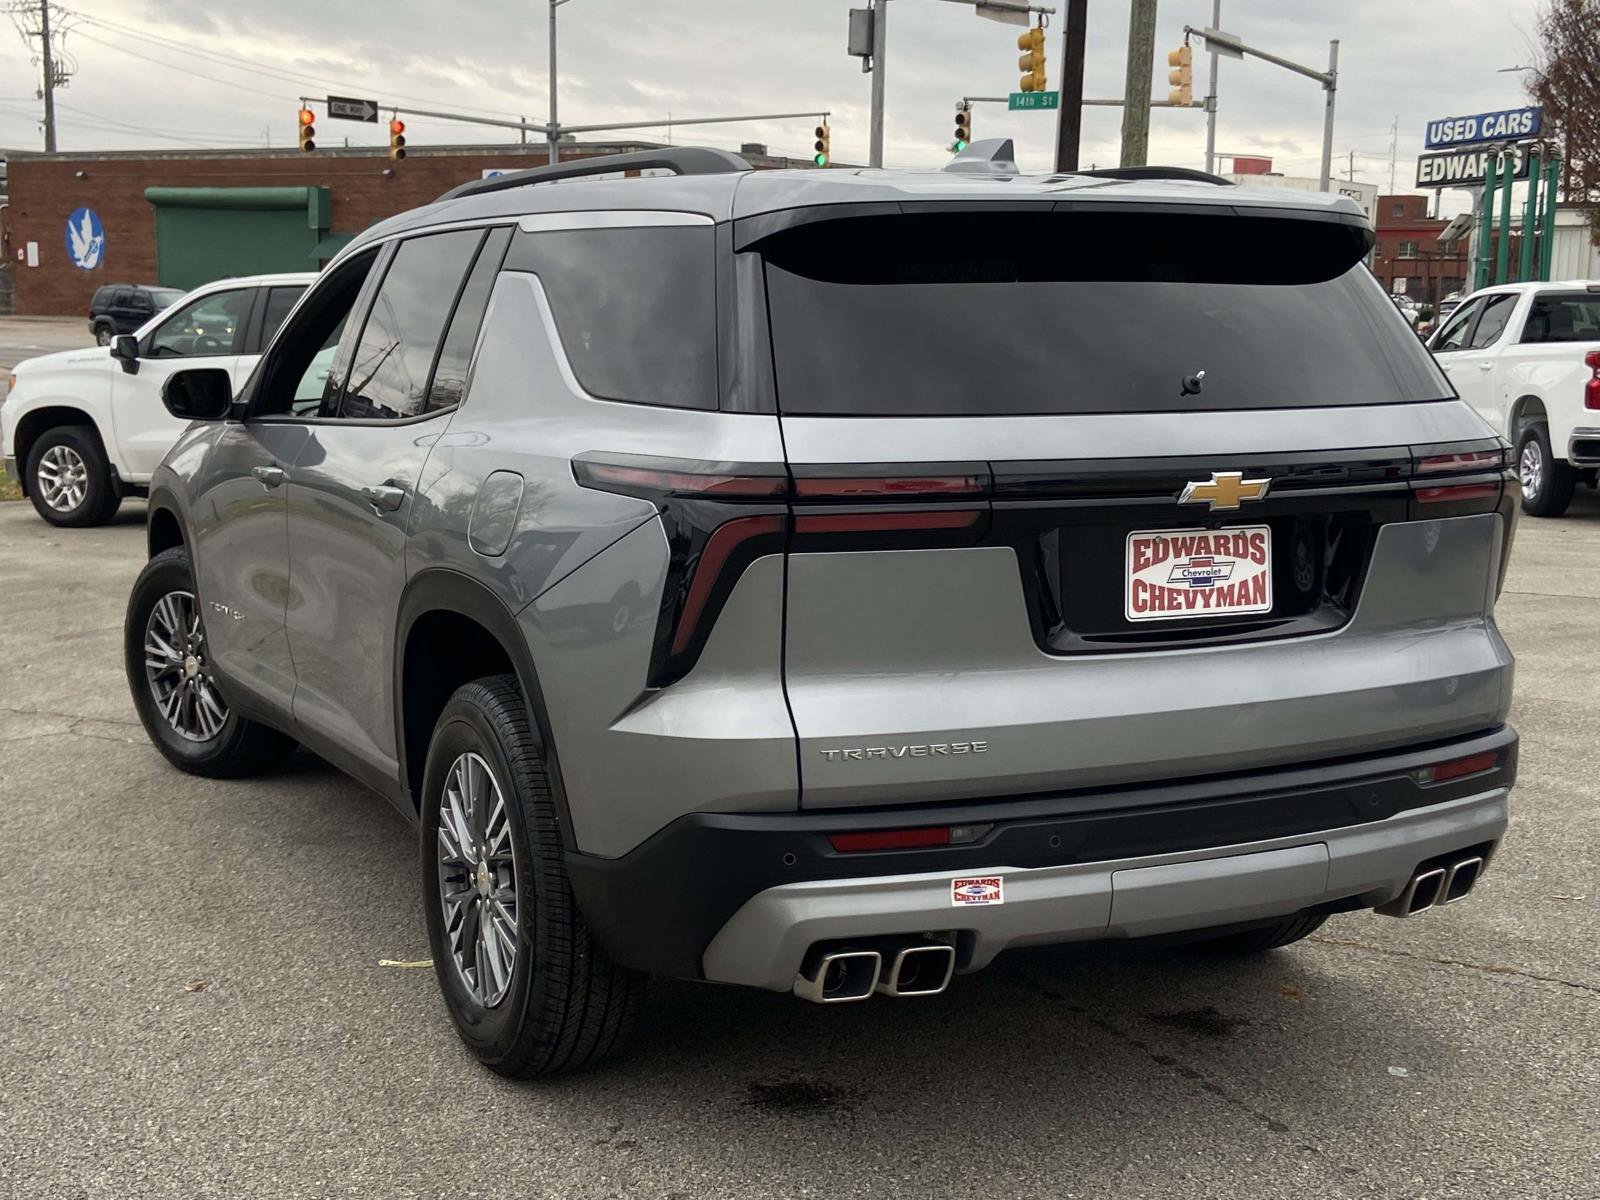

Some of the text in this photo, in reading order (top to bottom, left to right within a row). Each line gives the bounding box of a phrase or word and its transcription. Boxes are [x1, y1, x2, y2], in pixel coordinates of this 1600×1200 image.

[1016, 96, 1052, 106] 14th St
[1430, 112, 1532, 143] USED CARS
[1419, 149, 1522, 182] EDWARDS
[1132, 533, 1266, 574] EDWARDS
[1182, 568, 1222, 577] Chevrolet
[1132, 570, 1267, 613] CHEVYMAN
[820, 741, 988, 761] TRAVERSE
[954, 878, 1000, 890] EDWARDS
[954, 890, 1000, 901] CHEVYMAN
